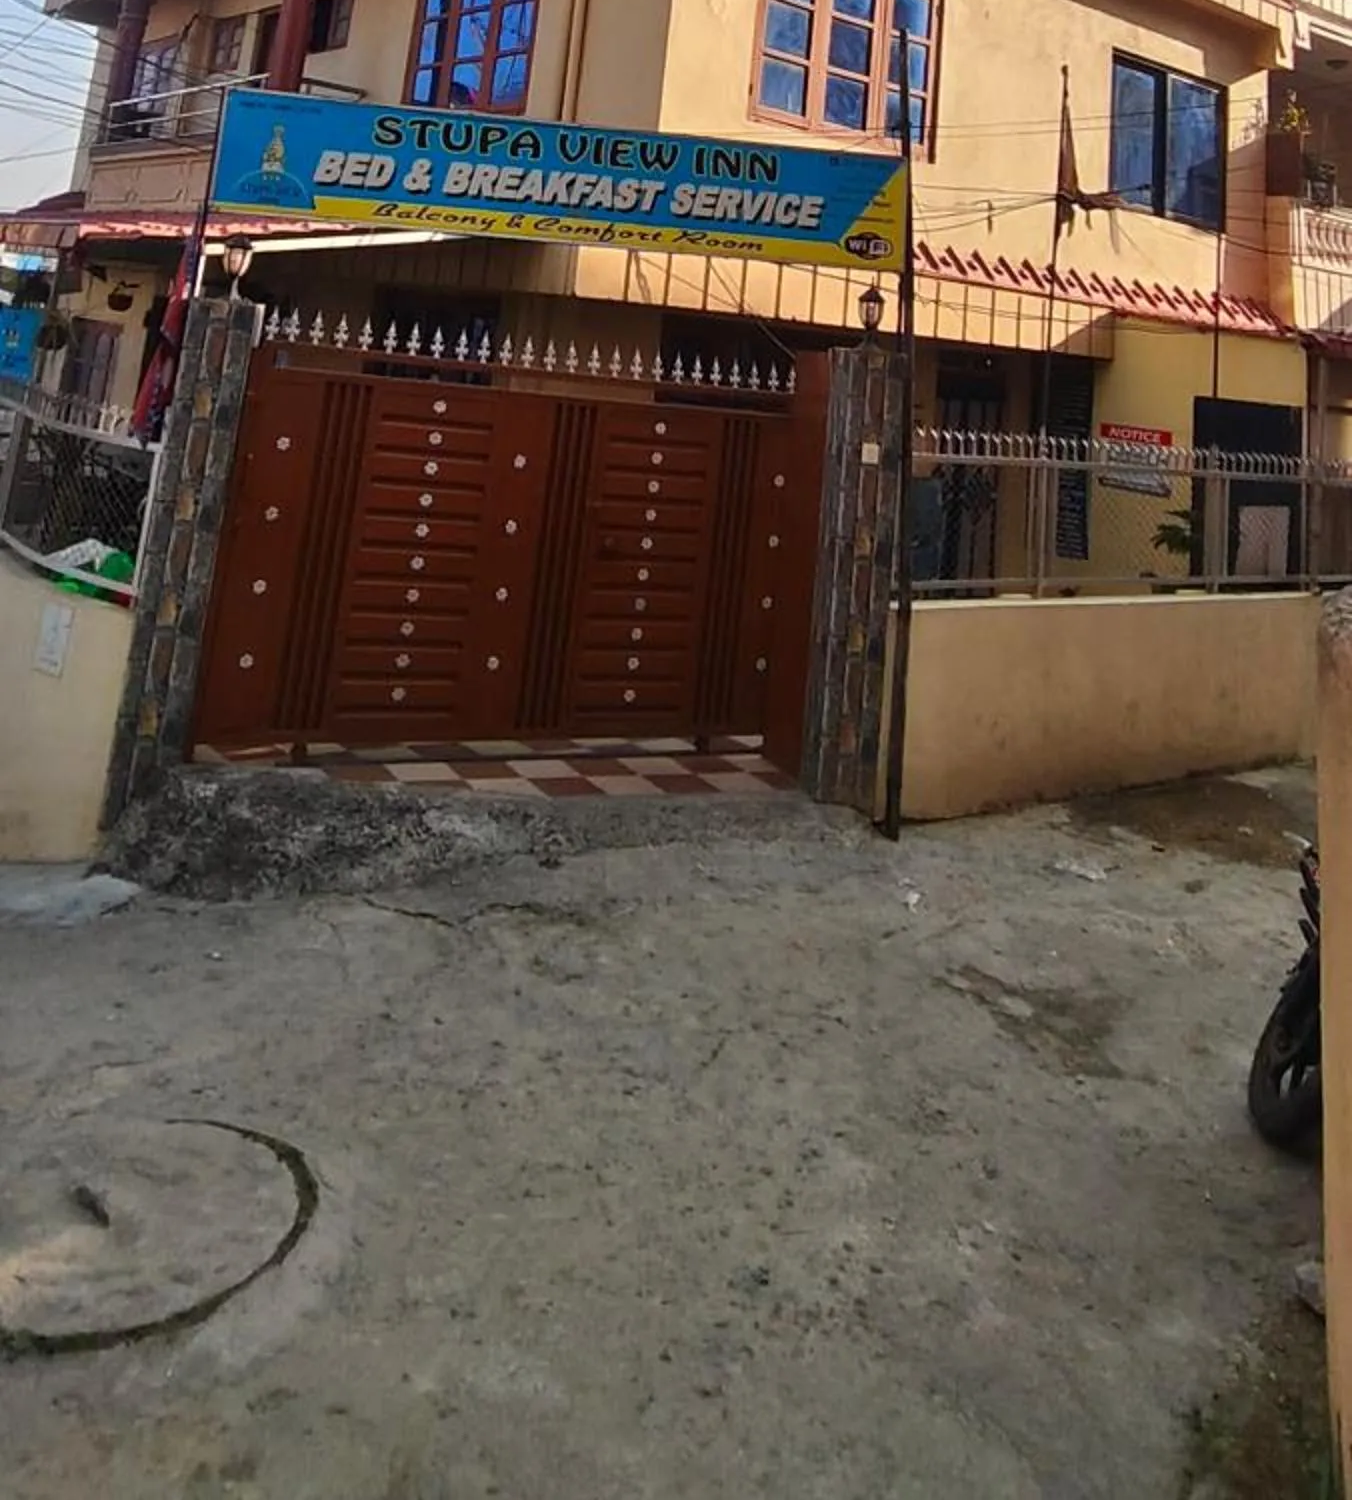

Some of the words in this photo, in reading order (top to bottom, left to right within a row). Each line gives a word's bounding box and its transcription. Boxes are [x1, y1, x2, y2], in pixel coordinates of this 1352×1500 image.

[374, 115, 542, 160] STUPA
[559, 132, 680, 174] VIEW
[694, 148, 778, 182] INN
[313, 151, 396, 188] BED
[402, 158, 434, 194] &
[443, 162, 665, 213] BREAKFAST
[670, 182, 826, 230] SERVICE
[372, 203, 496, 232] Balcony
[504, 215, 525, 230] &
[533, 217, 663, 243] Comfort
[671, 230, 765, 252] Room
[1107, 426, 1163, 443] NOTICE
